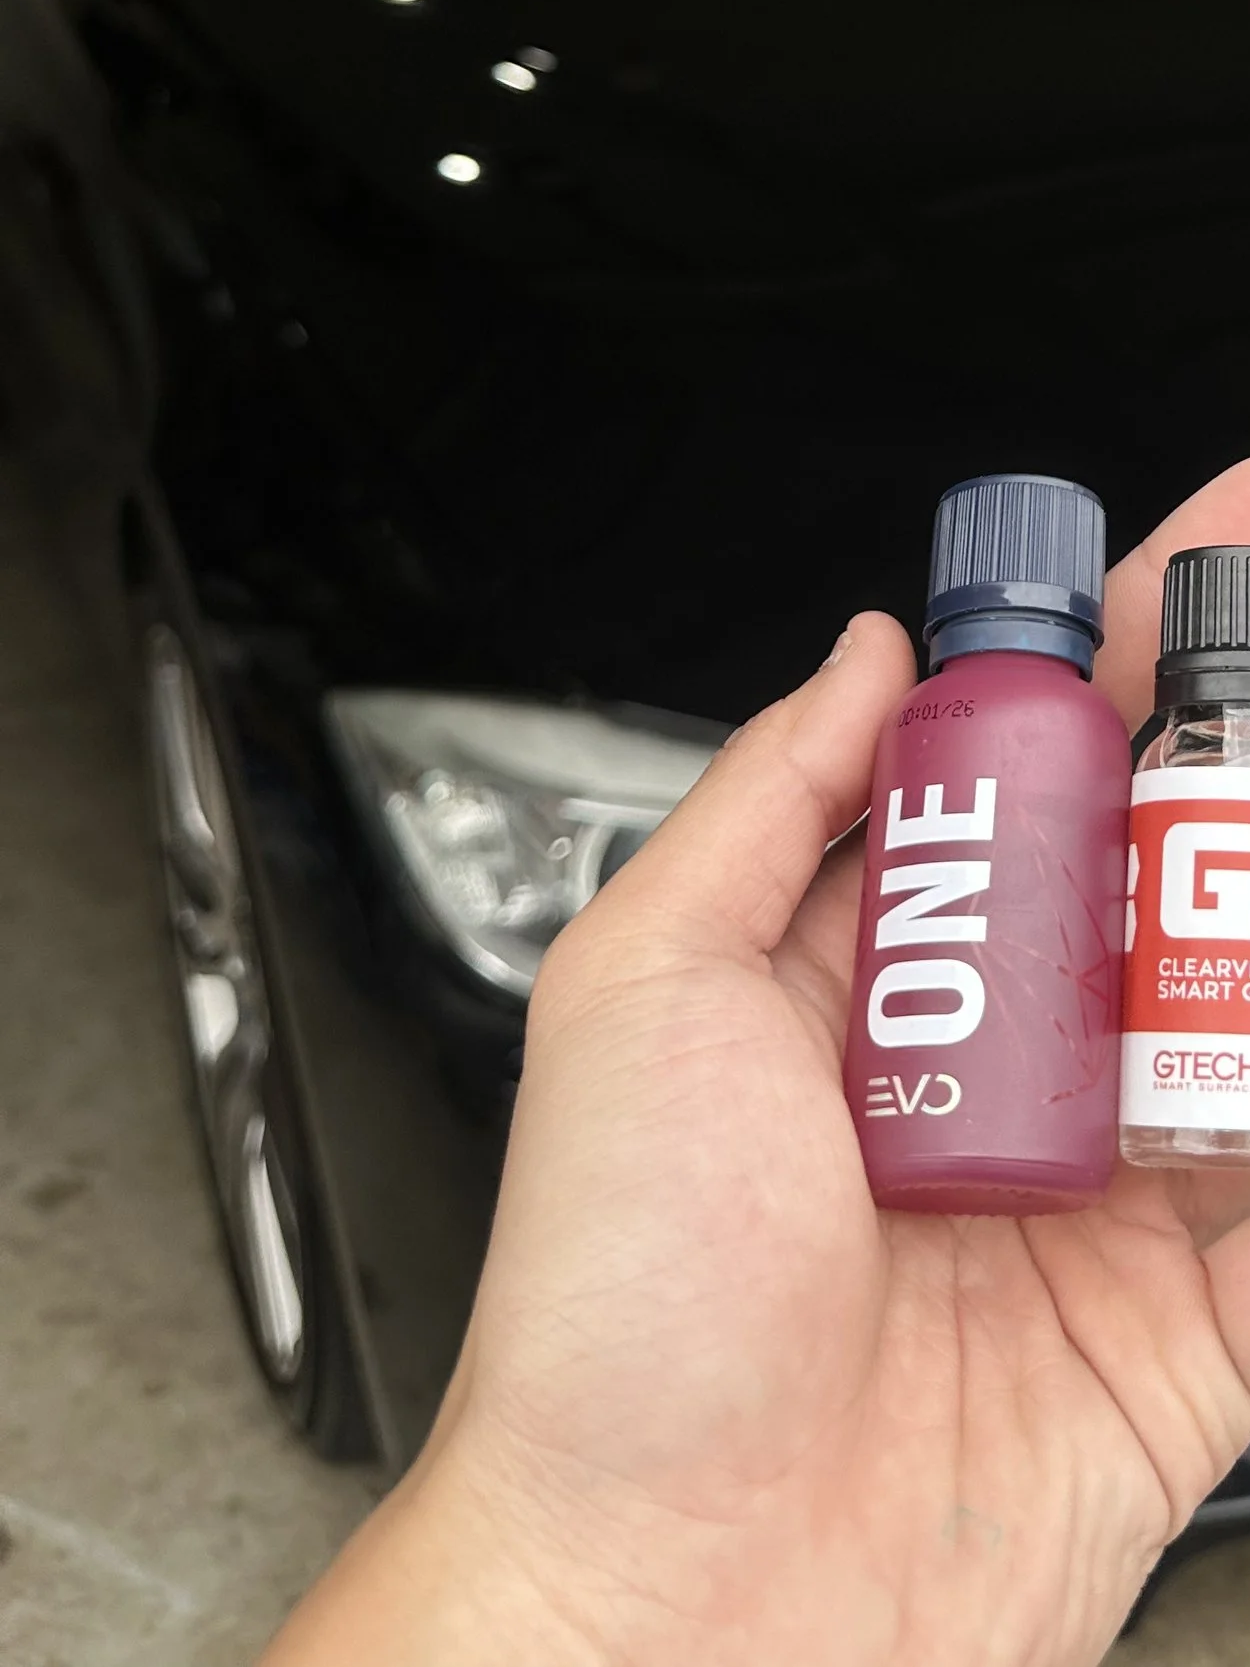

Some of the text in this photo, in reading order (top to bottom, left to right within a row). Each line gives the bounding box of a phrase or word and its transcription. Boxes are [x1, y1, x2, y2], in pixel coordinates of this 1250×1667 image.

[866, 777, 998, 1049] ONE
[1157, 979, 1235, 1002] SMART
[865, 1072, 963, 1118] EVO
[1153, 1081, 1192, 1092] SMART
